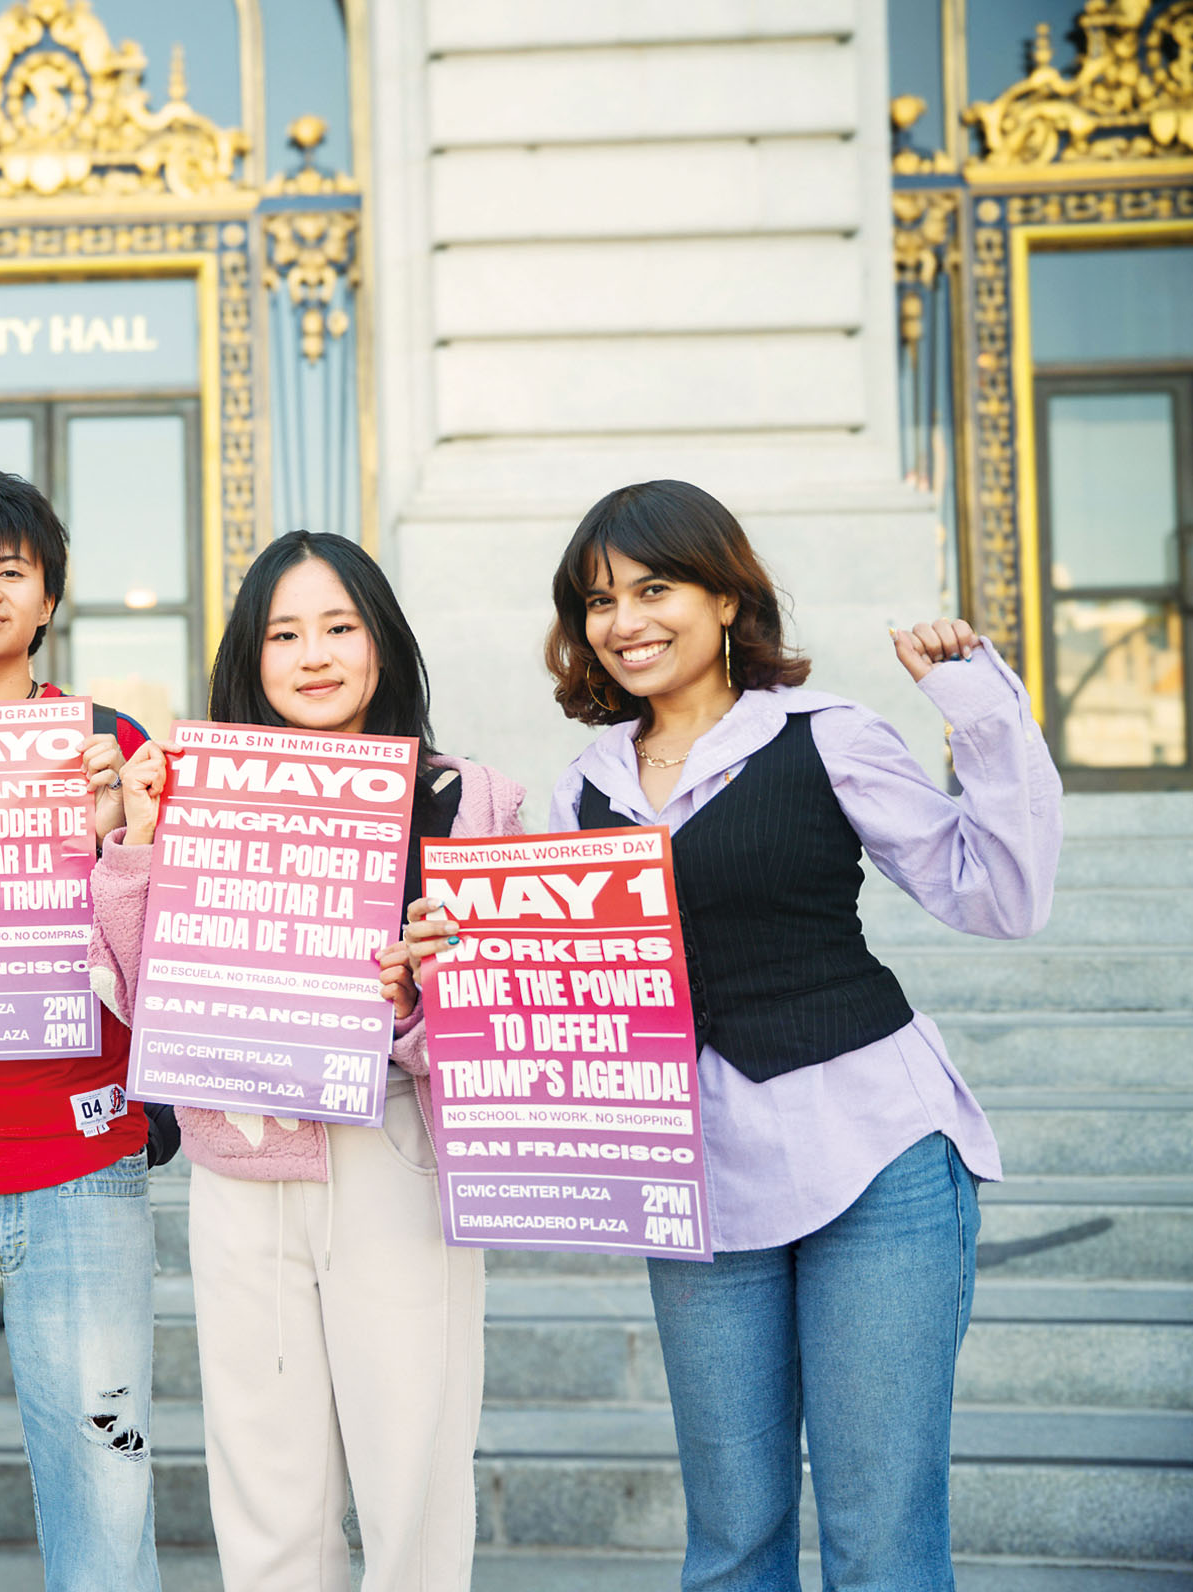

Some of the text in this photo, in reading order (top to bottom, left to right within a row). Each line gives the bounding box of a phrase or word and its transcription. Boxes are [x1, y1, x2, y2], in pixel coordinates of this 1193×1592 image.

[49, 313, 159, 354] HALL
[181, 732, 404, 758] UN DIA SIN INMIGRANTES
[172, 755, 407, 803] 1 MAYO
[59, 806, 87, 836] DE
[164, 806, 403, 842] INMIGRANTES
[25, 843, 53, 873] LA
[162, 834, 397, 883] TIENEN EL PODER DE
[428, 840, 655, 863] INTERNATIONAL WORKERS' DAY
[0, 879, 88, 911] TRUMP!
[195, 877, 354, 919] DERROTAR LA
[425, 867, 670, 921] MAY 1
[15, 931, 31, 940] NO
[32, 929, 88, 939] COMPRAS.
[154, 912, 249, 950] AGENDA
[256, 920, 286, 953] DE
[152, 965, 169, 974] NO
[171, 966, 225, 980] ESCUELA.
[227, 971, 243, 981] NO
[303, 979, 319, 989] NO
[437, 968, 675, 1008] HAVE THE POWER
[43, 996, 86, 1020] 2PM
[144, 996, 383, 1032] SAN FRANCISCO
[43, 1023, 86, 1047] 4PM
[489, 1013, 629, 1053] TO DEFEAT
[147, 1040, 371, 1083] CIVIC CENTER PLAZA 2PM
[144, 1069, 368, 1113] EMBARCADERO PLAZA 4PM
[437, 1060, 690, 1102] TRUMP'S AGENDA!
[81, 1098, 102, 1119] 04
[448, 1111, 686, 1127] NO SCHOOL. NO WORK. NO SHOPPING.
[446, 1141, 694, 1164] SAN FRANCISCO
[457, 1184, 690, 1215] CIVIC CENTER PLAZA 2PM
[459, 1215, 694, 1247] EMBARCADERO PLAZA 4PM
